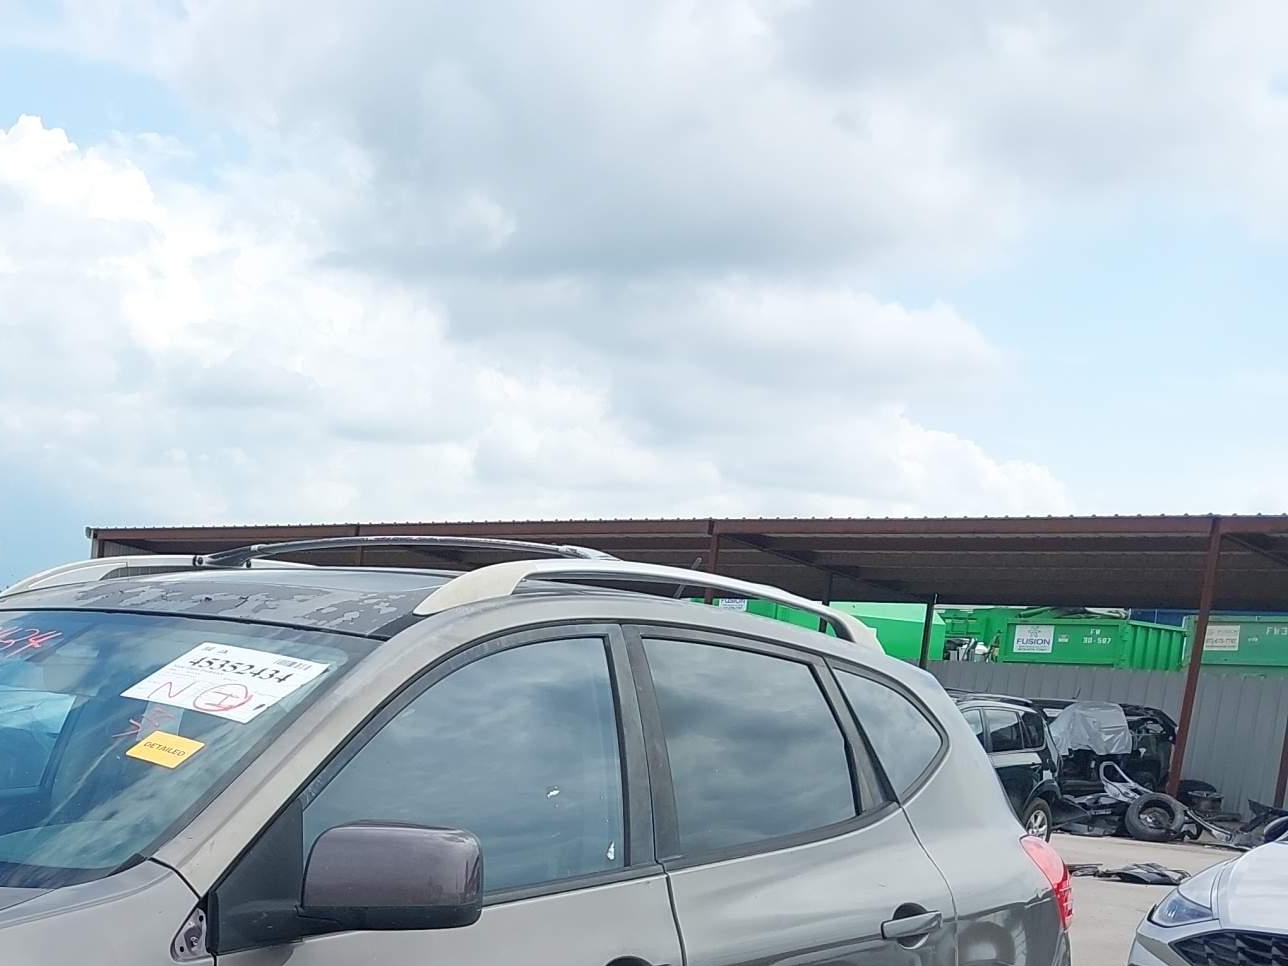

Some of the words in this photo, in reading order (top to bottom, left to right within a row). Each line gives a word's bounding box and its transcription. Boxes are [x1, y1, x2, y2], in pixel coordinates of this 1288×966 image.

[1016, 638, 1050, 646] FUSION
[189, 656, 294, 683] 45352434
[143, 741, 186, 757] DETAILED
